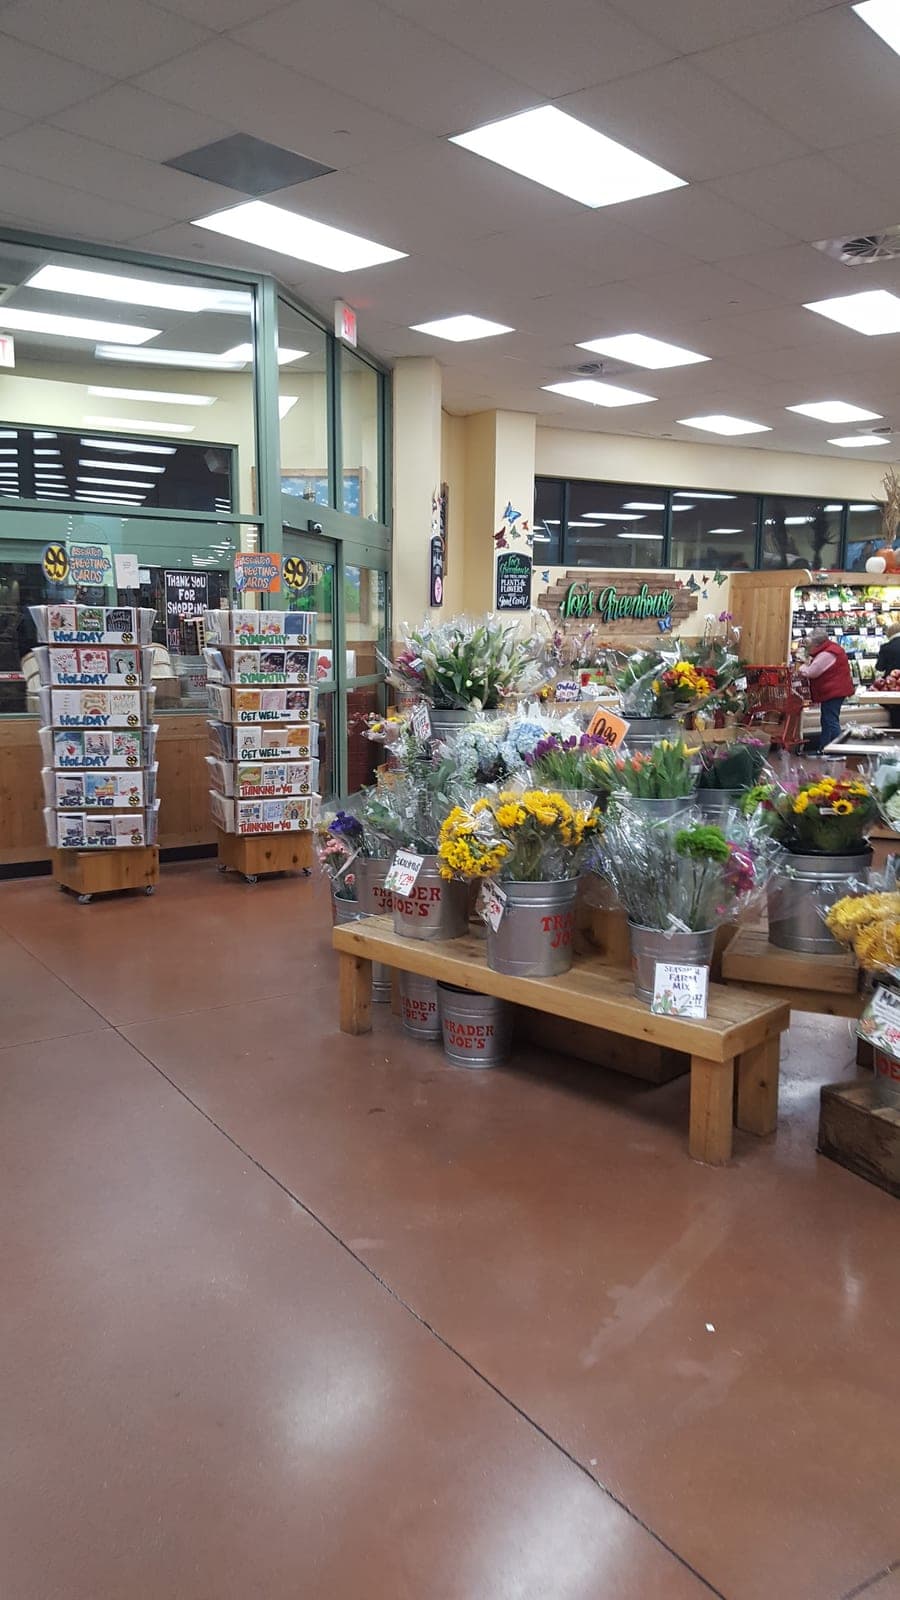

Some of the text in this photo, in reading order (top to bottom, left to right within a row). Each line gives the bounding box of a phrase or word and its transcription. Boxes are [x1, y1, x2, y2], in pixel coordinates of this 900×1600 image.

[72, 570, 102, 583] CARDS
[192, 575, 206, 588] YOU
[178, 588, 196, 601] FOR
[560, 581, 675, 624] Joe's Greenhouse
[239, 634, 286, 645] SYMPATHY
[239, 673, 286, 683] SYMPATHY
[241, 711, 257, 721] GET
[258, 711, 280, 720] WELL
[241, 749, 257, 758] GET
[259, 749, 280, 757] WELL
[673, 983, 690, 991] MIX
[448, 1035, 486, 1049] JOE'S
